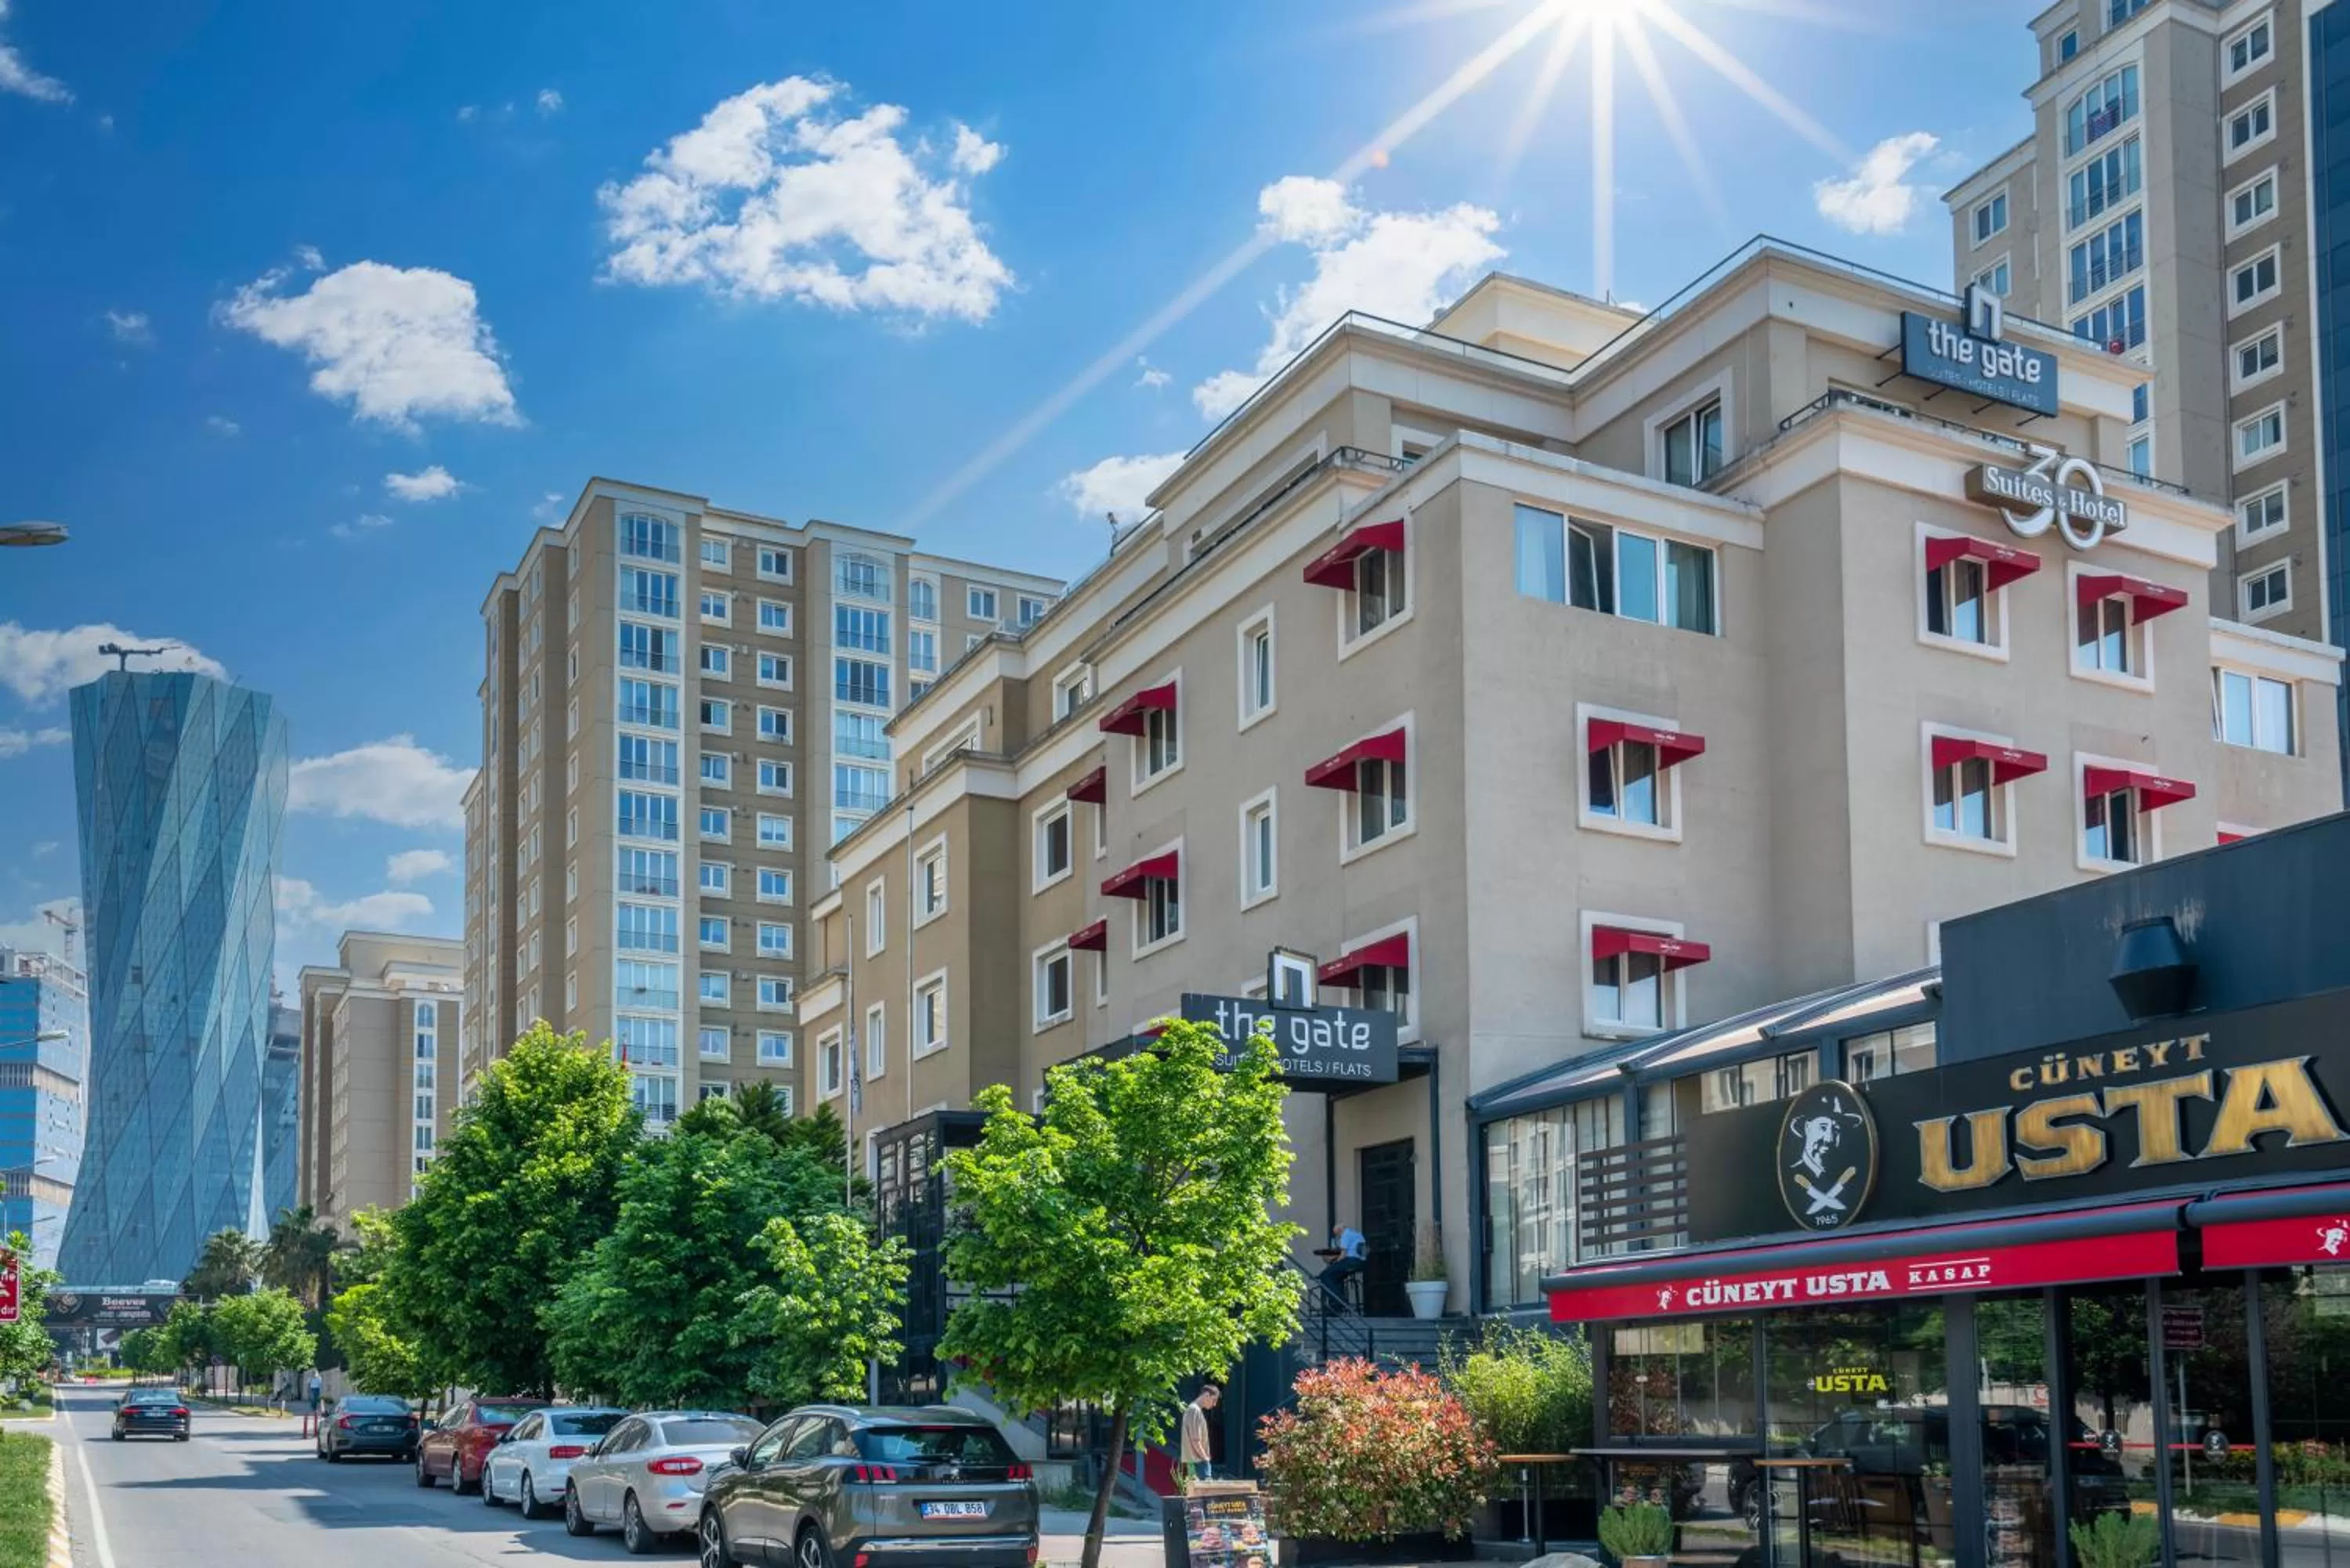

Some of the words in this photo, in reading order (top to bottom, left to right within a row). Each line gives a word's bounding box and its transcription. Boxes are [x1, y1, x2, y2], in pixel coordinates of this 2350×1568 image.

[1928, 320, 1974, 364] the
[1981, 344, 2041, 384] gate
[1987, 466, 2054, 508] Suites
[2069, 488, 2125, 527] Hotel
[1215, 1000, 1276, 1041] the
[1291, 1010, 1370, 1055] gate
[1276, 1058, 1323, 1074] OTELS
[1333, 1061, 1372, 1077] FLATS
[2009, 1033, 2211, 1091] CÜNEYT
[1912, 1055, 2350, 1191] USTA
[1814, 1214, 1838, 1225] 1965
[1686, 1278, 1798, 1306] CÜNEYT
[1806, 1270, 1891, 1296] USTA
[1908, 1265, 1991, 1284] KASAP
[1816, 1375, 1887, 1392] USTA
